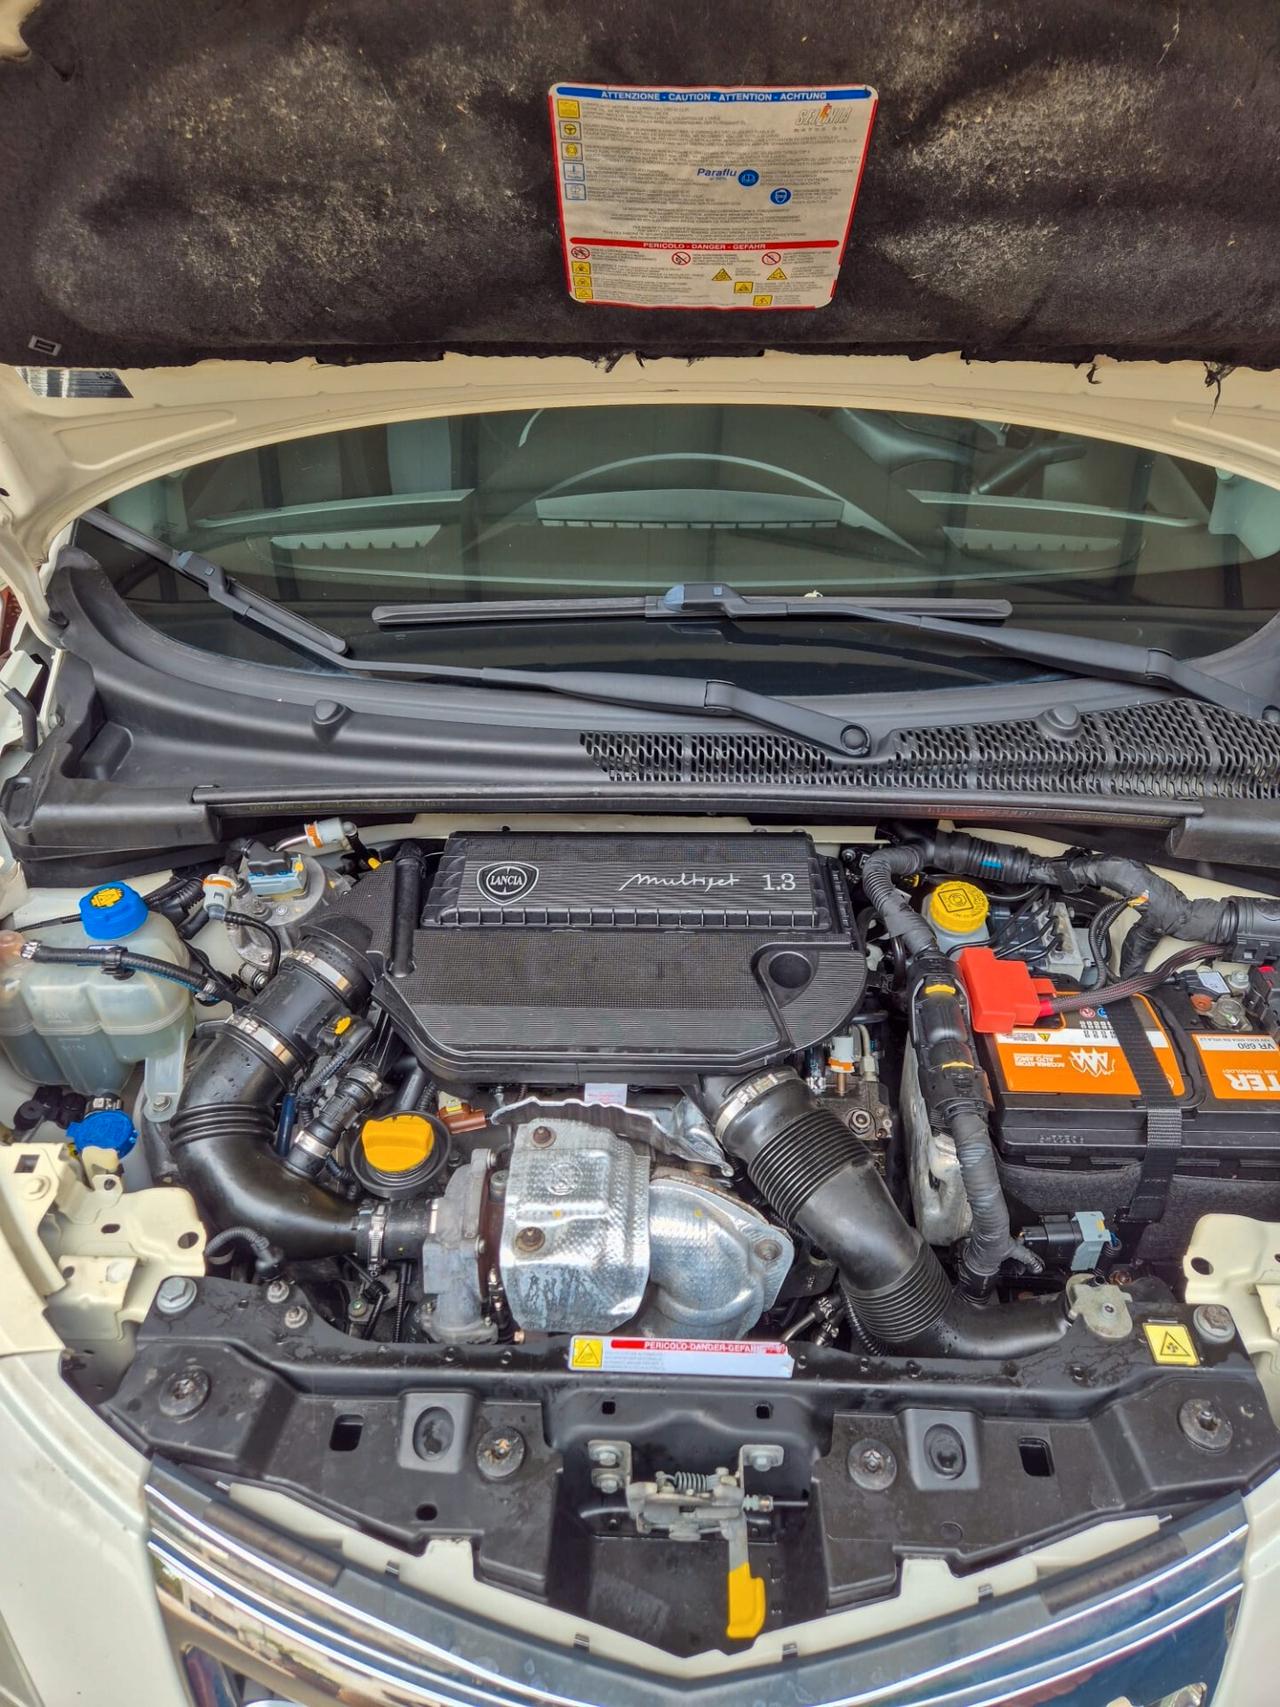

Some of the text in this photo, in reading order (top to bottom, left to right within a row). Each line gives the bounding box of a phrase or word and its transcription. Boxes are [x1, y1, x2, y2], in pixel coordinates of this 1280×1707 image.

[601, 91, 827, 101] ATTENZIONE CAUTION ATTENTION ACHTUNG
[696, 168, 737, 177] Paraflu
[490, 875, 523, 886] LANCIA
[761, 873, 797, 891] 1.3
